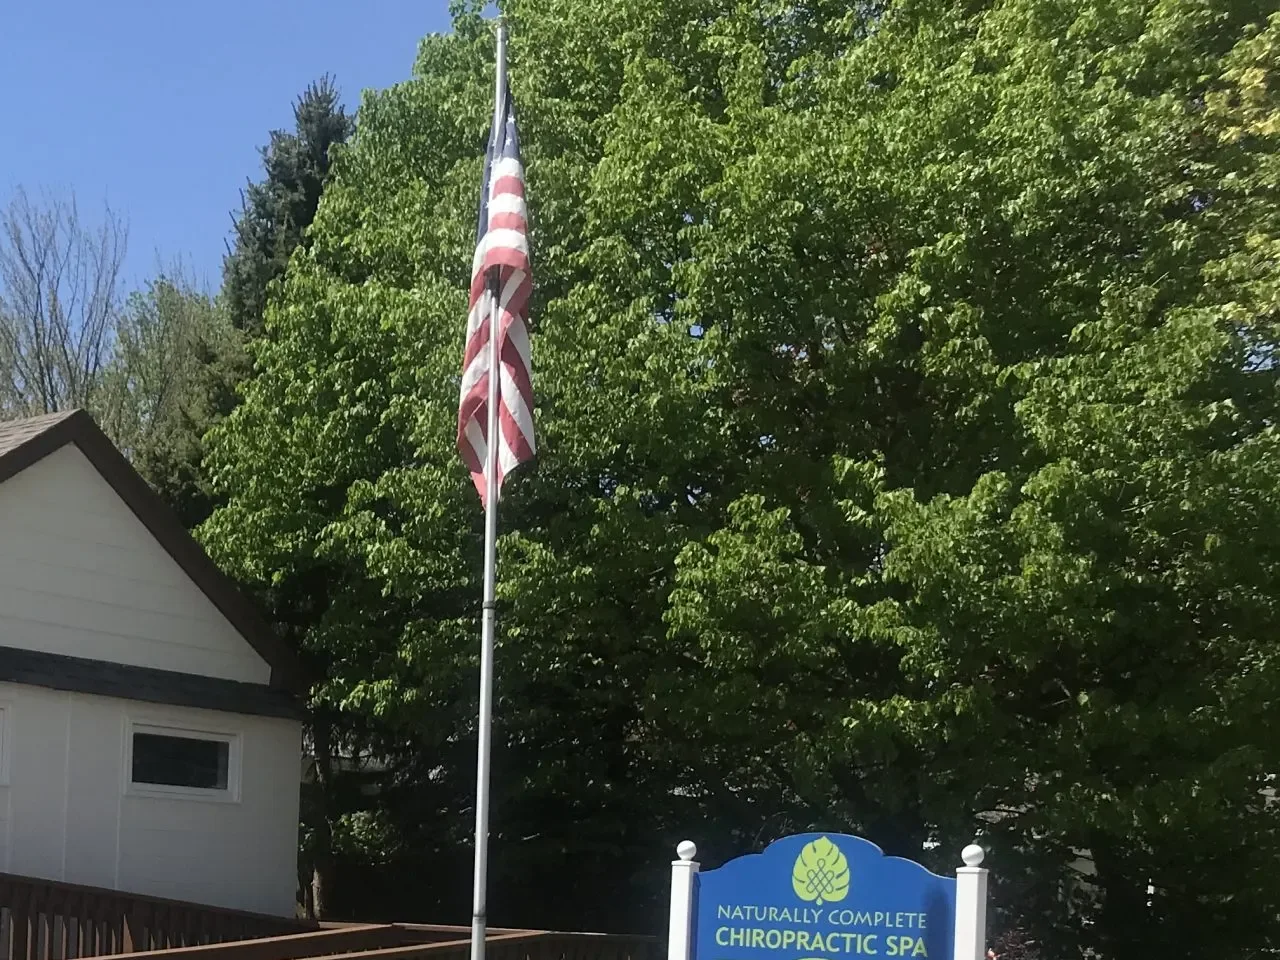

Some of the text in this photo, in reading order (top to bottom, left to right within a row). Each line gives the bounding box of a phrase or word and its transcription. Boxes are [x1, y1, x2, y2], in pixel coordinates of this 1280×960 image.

[718, 905, 927, 929] NATURALLY COMPLETE
[715, 927, 928, 958] CHIROPRACTIC SPA
